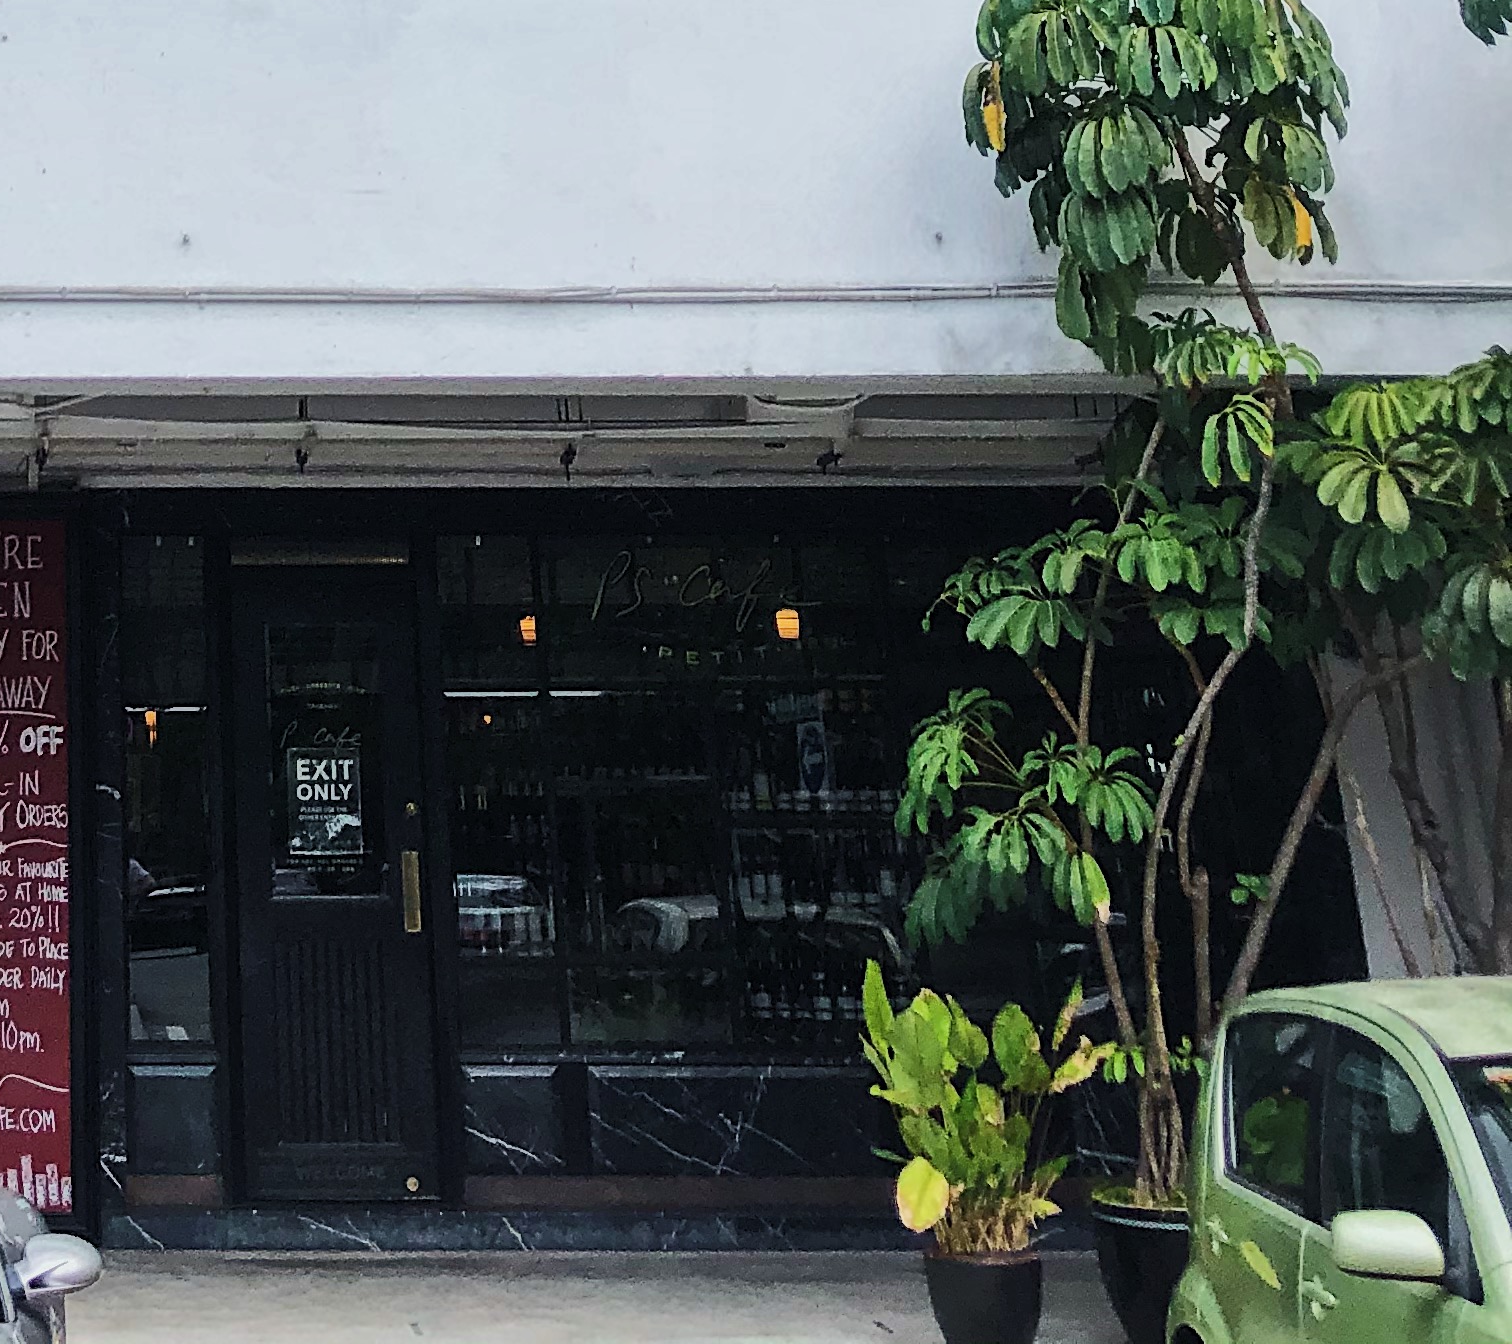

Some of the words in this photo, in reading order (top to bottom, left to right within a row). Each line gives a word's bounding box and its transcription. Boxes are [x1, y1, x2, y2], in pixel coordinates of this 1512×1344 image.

[21, 629, 59, 663] FOR
[19, 725, 64, 756] OFF
[296, 758, 354, 781] EXIT
[296, 783, 354, 801] ONLY
[16, 799, 68, 829] ORDERS
[15, 882, 31, 902] AT
[38, 882, 68, 902] HOME
[20, 938, 35, 957] TO
[31, 965, 66, 995] DAILY
